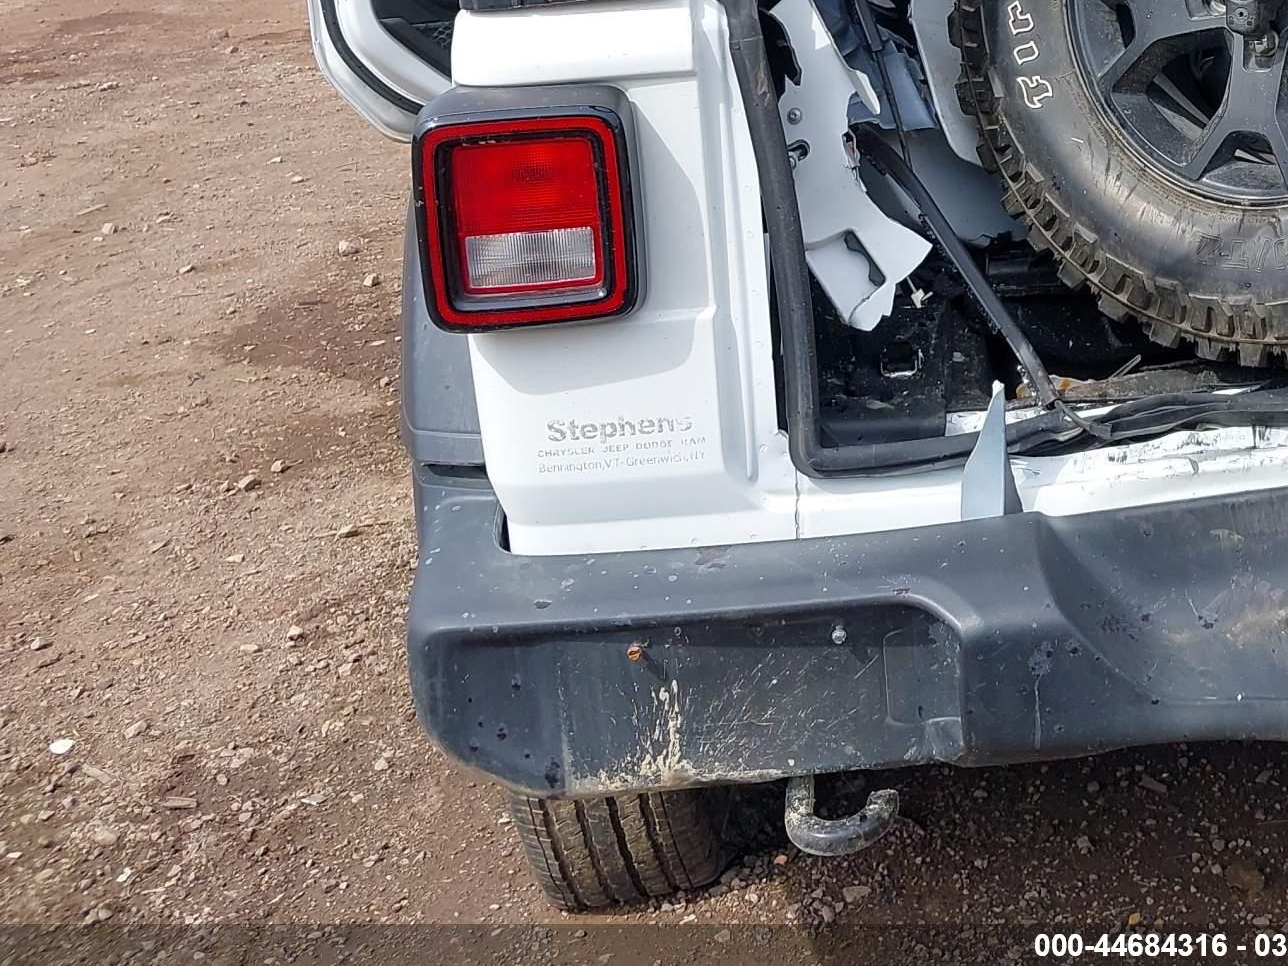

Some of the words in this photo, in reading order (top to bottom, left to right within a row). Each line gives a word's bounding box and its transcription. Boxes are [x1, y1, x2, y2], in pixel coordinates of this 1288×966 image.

[546, 416, 693, 444] Stephens
[537, 446, 596, 458] CHRYSLER
[601, 443, 629, 453] JEEP
